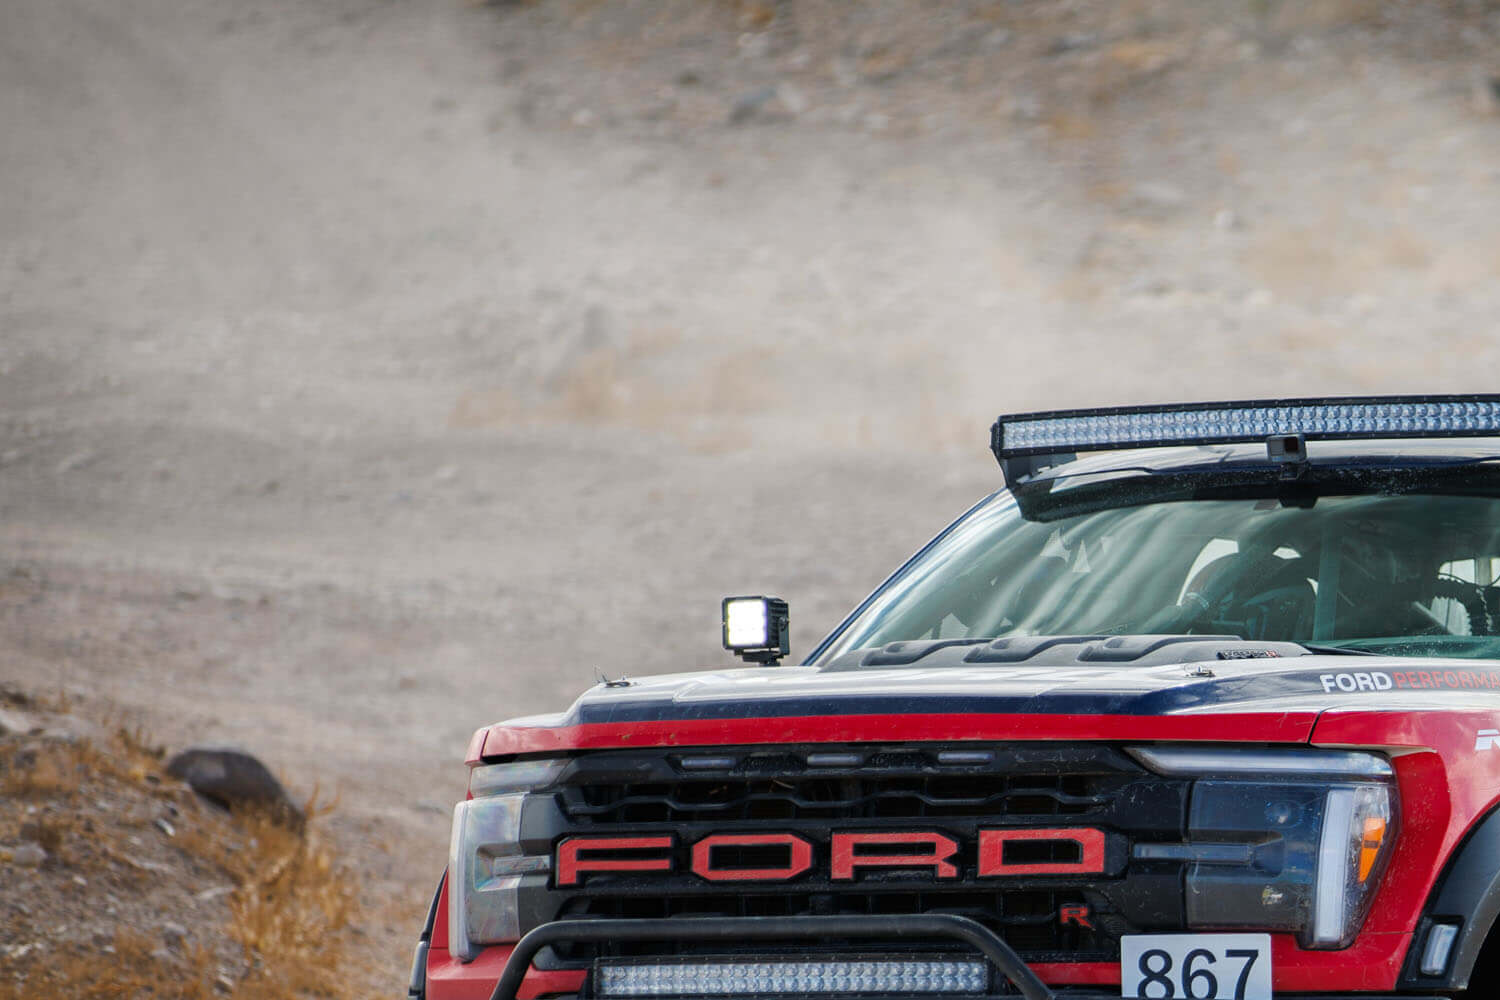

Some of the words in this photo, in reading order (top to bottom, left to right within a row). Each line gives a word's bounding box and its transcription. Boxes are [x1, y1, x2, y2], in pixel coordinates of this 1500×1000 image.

[1318, 671, 1393, 693] FORD
[555, 827, 1105, 887] FORD
[1060, 906, 1094, 929] R
[1136, 948, 1259, 1000] 867
